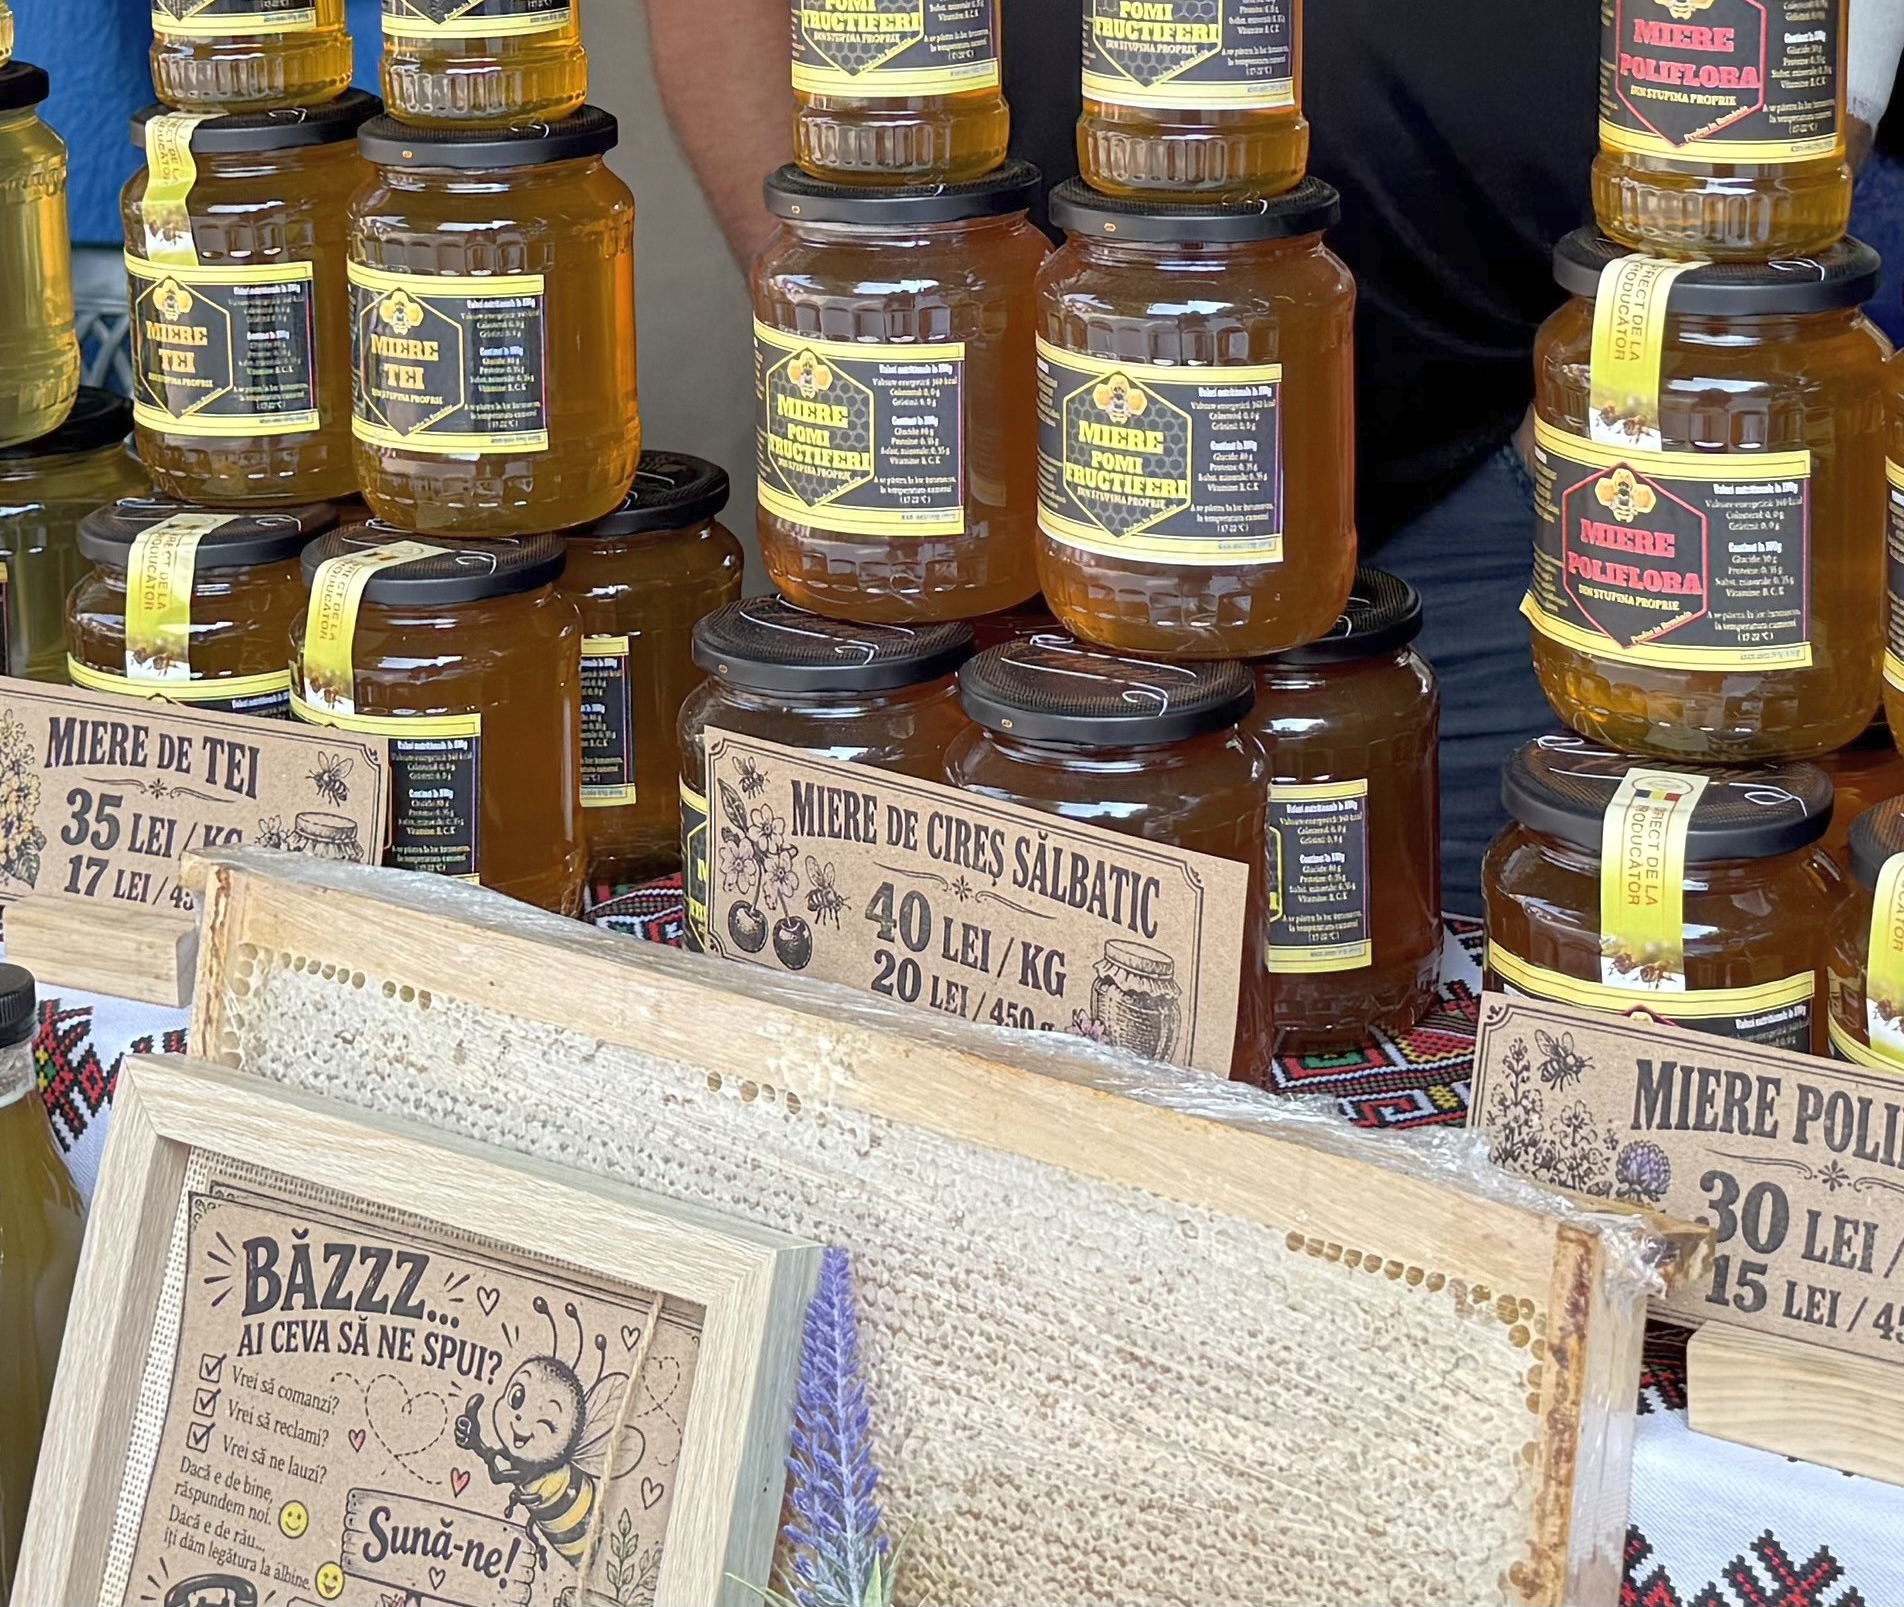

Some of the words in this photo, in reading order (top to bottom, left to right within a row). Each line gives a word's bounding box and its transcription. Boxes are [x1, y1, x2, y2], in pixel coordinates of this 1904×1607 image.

[1079, 420, 1164, 454] MIERE
[1091, 450, 1143, 473] POMI
[1065, 462, 1188, 500] FRUCTIFERI
[44, 716, 149, 769] MIERE
[157, 733, 193, 774] DE
[202, 736, 261, 800] TEI
[61, 787, 124, 851] 35
[128, 812, 177, 858] LEI
[791, 780, 878, 845] MIERE
[886, 804, 918, 852] DE
[927, 810, 1006, 886] CIREȘ
[1012, 831, 1160, 939] SĂLBATIC
[865, 881, 932, 952] 40
[942, 915, 992, 973] LEI
[1018, 940, 1067, 998] KG
[1630, 1058, 1782, 1140] MIERE
[1696, 1169, 1790, 1255] 30
[1801, 1208, 1879, 1274] LEI
[241, 1226, 459, 1329] BĂZZZ...
[1704, 1253, 1770, 1314] 15
[1782, 1279, 1842, 1329] LEI
[237, 1322, 265, 1358] AI
[271, 1320, 330, 1353] CEVA
[337, 1315, 369, 1358] SĂ
[377, 1324, 415, 1363] NE
[422, 1331, 503, 1386] SPUI?
[232, 1365, 258, 1390] Vrei
[261, 1378, 275, 1395] să
[278, 1384, 340, 1416] comanzi?
[228, 1398, 253, 1424] Vrei
[256, 1412, 271, 1430] să
[274, 1418, 329, 1448] reclami?
[180, 1455, 211, 1480] Dacă
[214, 1471, 222, 1483] e
[224, 1472, 241, 1490] de
[243, 1476, 275, 1505] bine,
[223, 1434, 248, 1460] Vrei
[252, 1447, 266, 1465] să
[269, 1454, 285, 1471] ne
[287, 1457, 328, 1485] lauzi?
[168, 1505, 201, 1532] Dacă
[203, 1521, 212, 1533] e
[214, 1522, 231, 1542] de
[233, 1530, 266, 1553] rău...
[174, 1481, 245, 1517] răspundem
[248, 1502, 272, 1526] noi.
[179, 1532, 205, 1555] dăm
[207, 1539, 258, 1573] legătura
[260, 1555, 272, 1575] la
[362, 1505, 522, 1590] Sună-ne!
